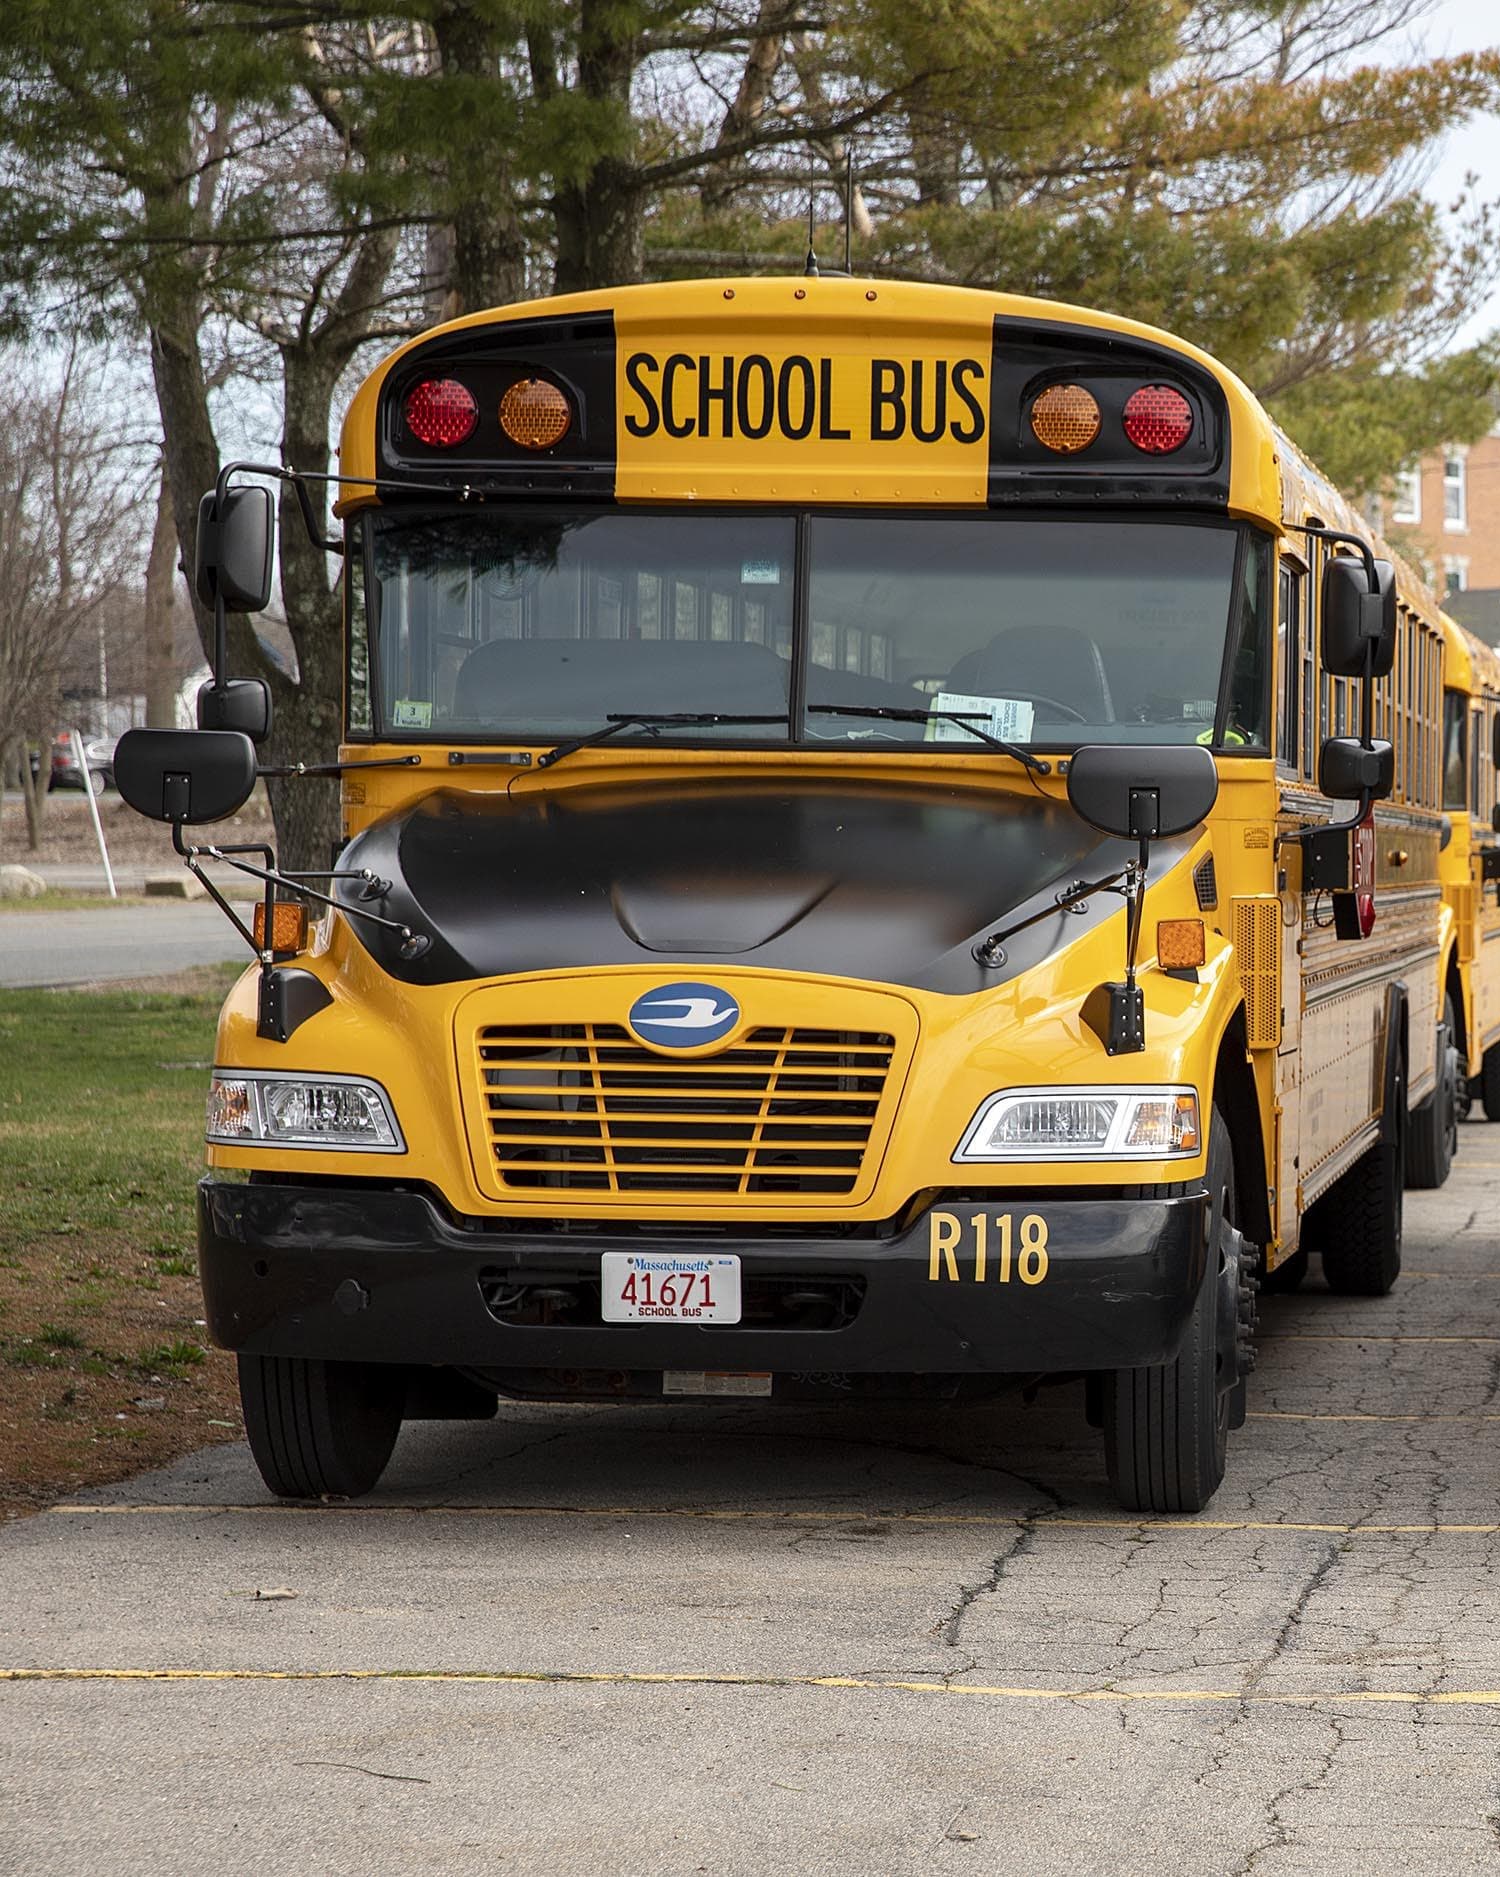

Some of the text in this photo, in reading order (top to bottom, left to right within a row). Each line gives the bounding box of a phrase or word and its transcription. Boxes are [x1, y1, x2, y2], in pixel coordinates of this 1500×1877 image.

[624, 352, 986, 444] SCHOOL BUS
[633, 1258, 709, 1272] Massachusetts
[928, 1212, 1049, 1285] R118
[621, 1272, 716, 1307] 41671
[638, 1307, 702, 1317] SCHOOL BUS
